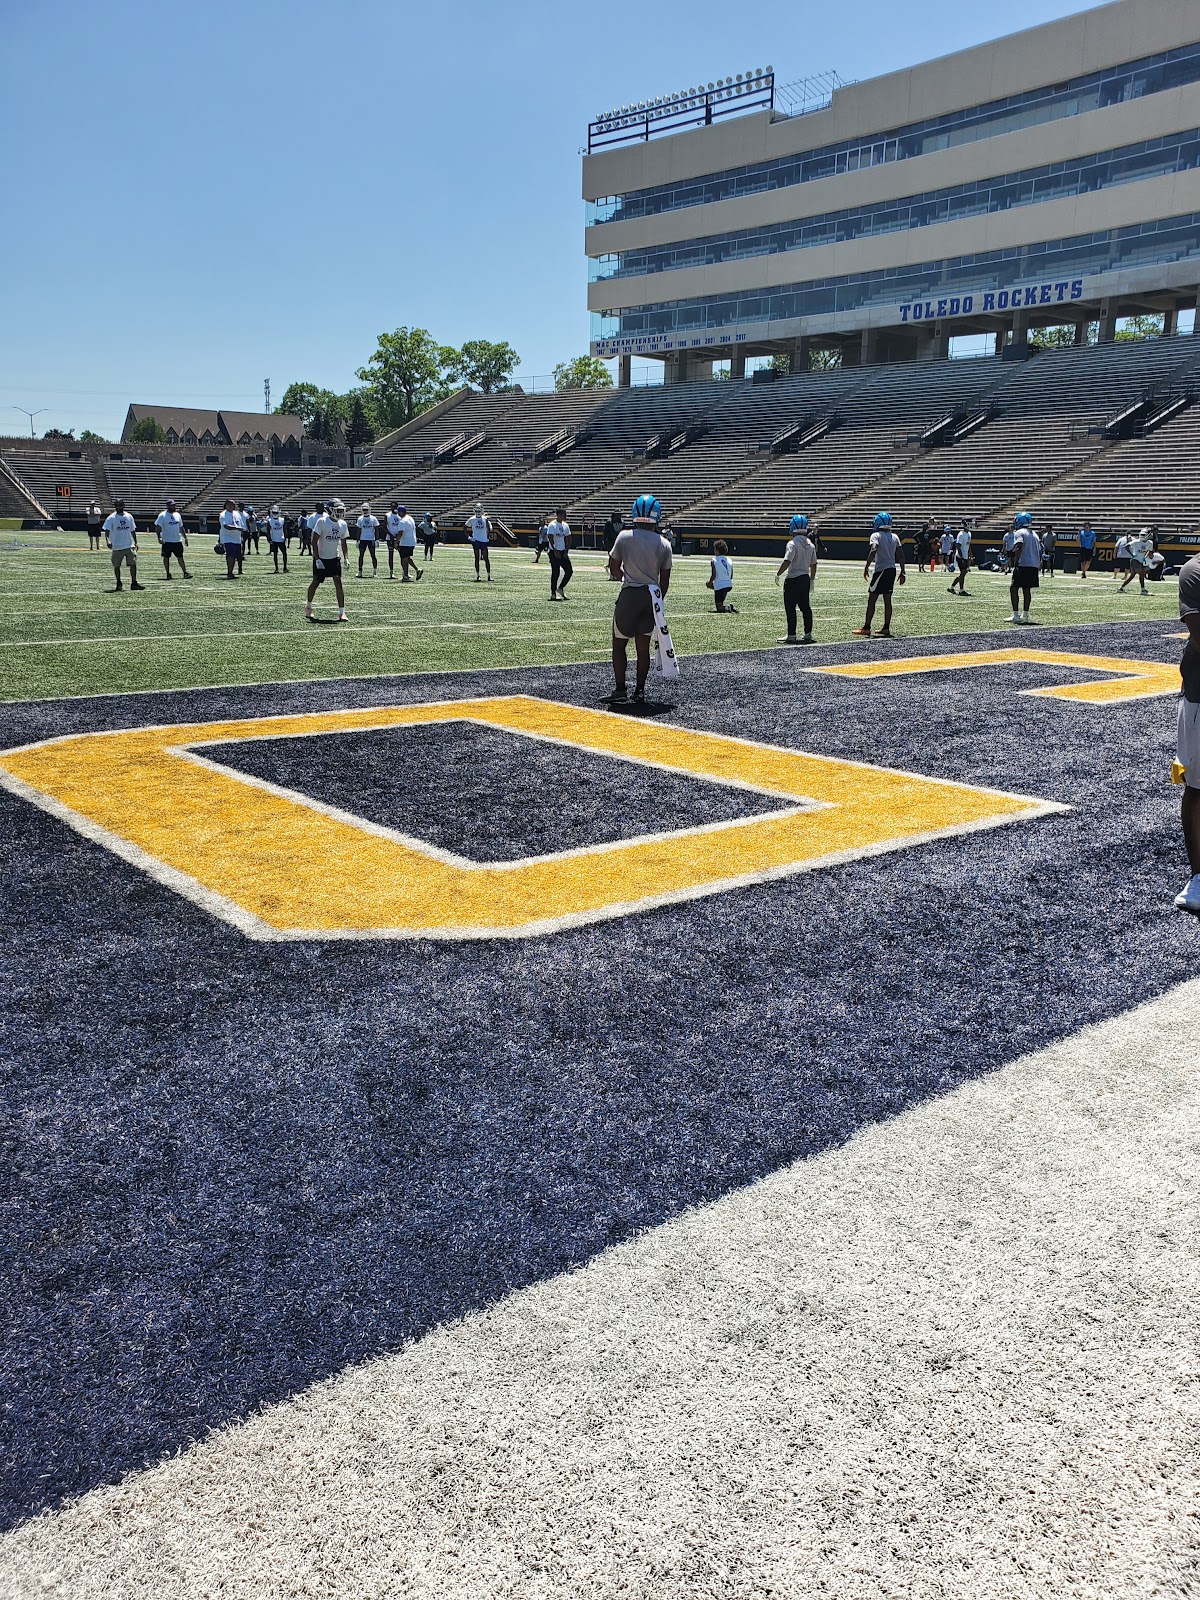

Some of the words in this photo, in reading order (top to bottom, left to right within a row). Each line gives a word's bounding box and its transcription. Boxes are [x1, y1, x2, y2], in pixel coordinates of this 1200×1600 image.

[899, 296, 973, 322] TOLEDO
[983, 279, 1083, 312] ROCKETS
[596, 341, 609, 349] MAC
[612, 335, 667, 347] CHAMPIONSHIPS
[736, 333, 746, 341] 2017
[57, 486, 70, 497] 40
[699, 538, 709, 547] 50
[1098, 549, 1113, 561] 20
